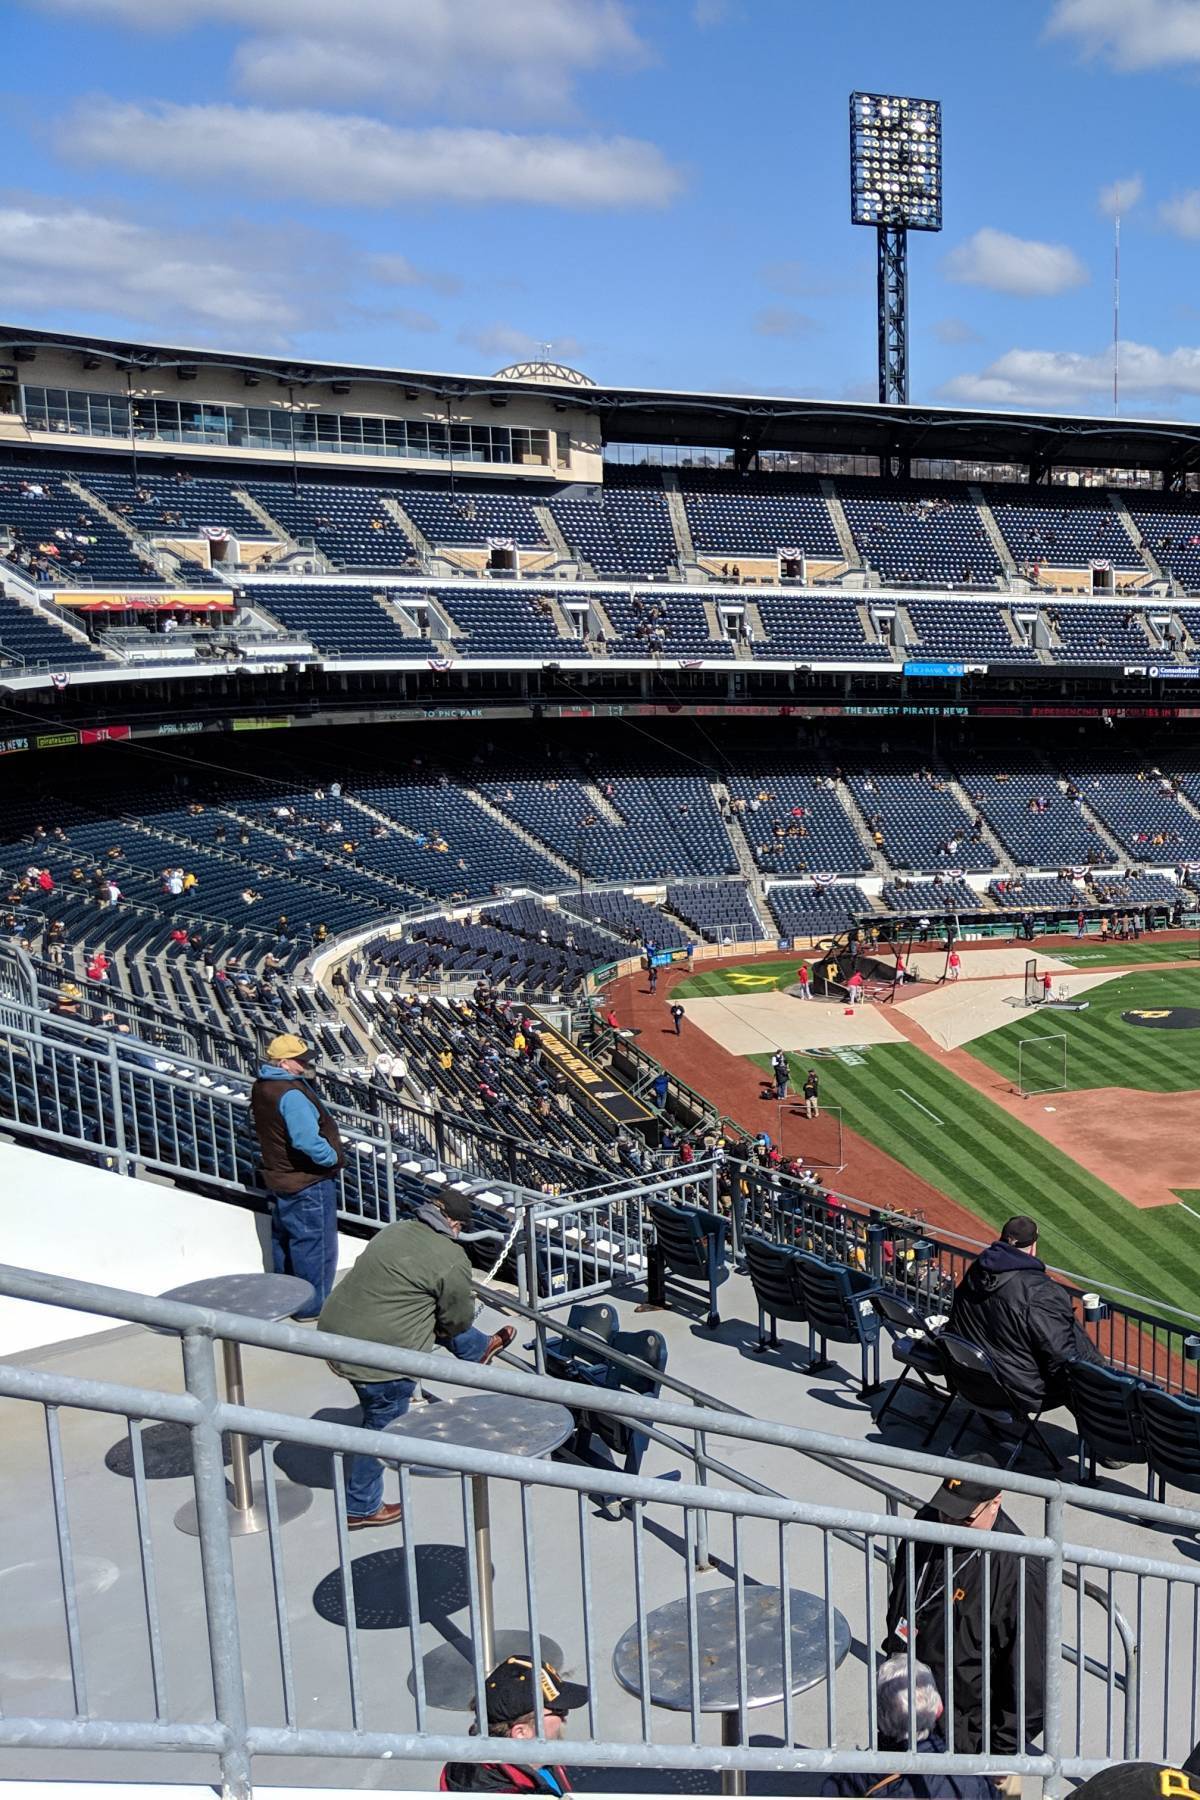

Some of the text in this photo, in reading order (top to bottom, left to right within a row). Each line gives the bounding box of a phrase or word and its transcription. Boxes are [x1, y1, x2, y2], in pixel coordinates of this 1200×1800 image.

[423, 710, 436, 719] TO
[439, 710, 458, 718] PNC
[460, 709, 482, 718] PARK
[845, 706, 863, 715] THE
[866, 706, 900, 715] LATEST
[902, 706, 940, 715] PIRATES
[943, 707, 969, 716] NEWS
[96, 728, 112, 741] STL
[7, 738, 29, 750] NEWS
